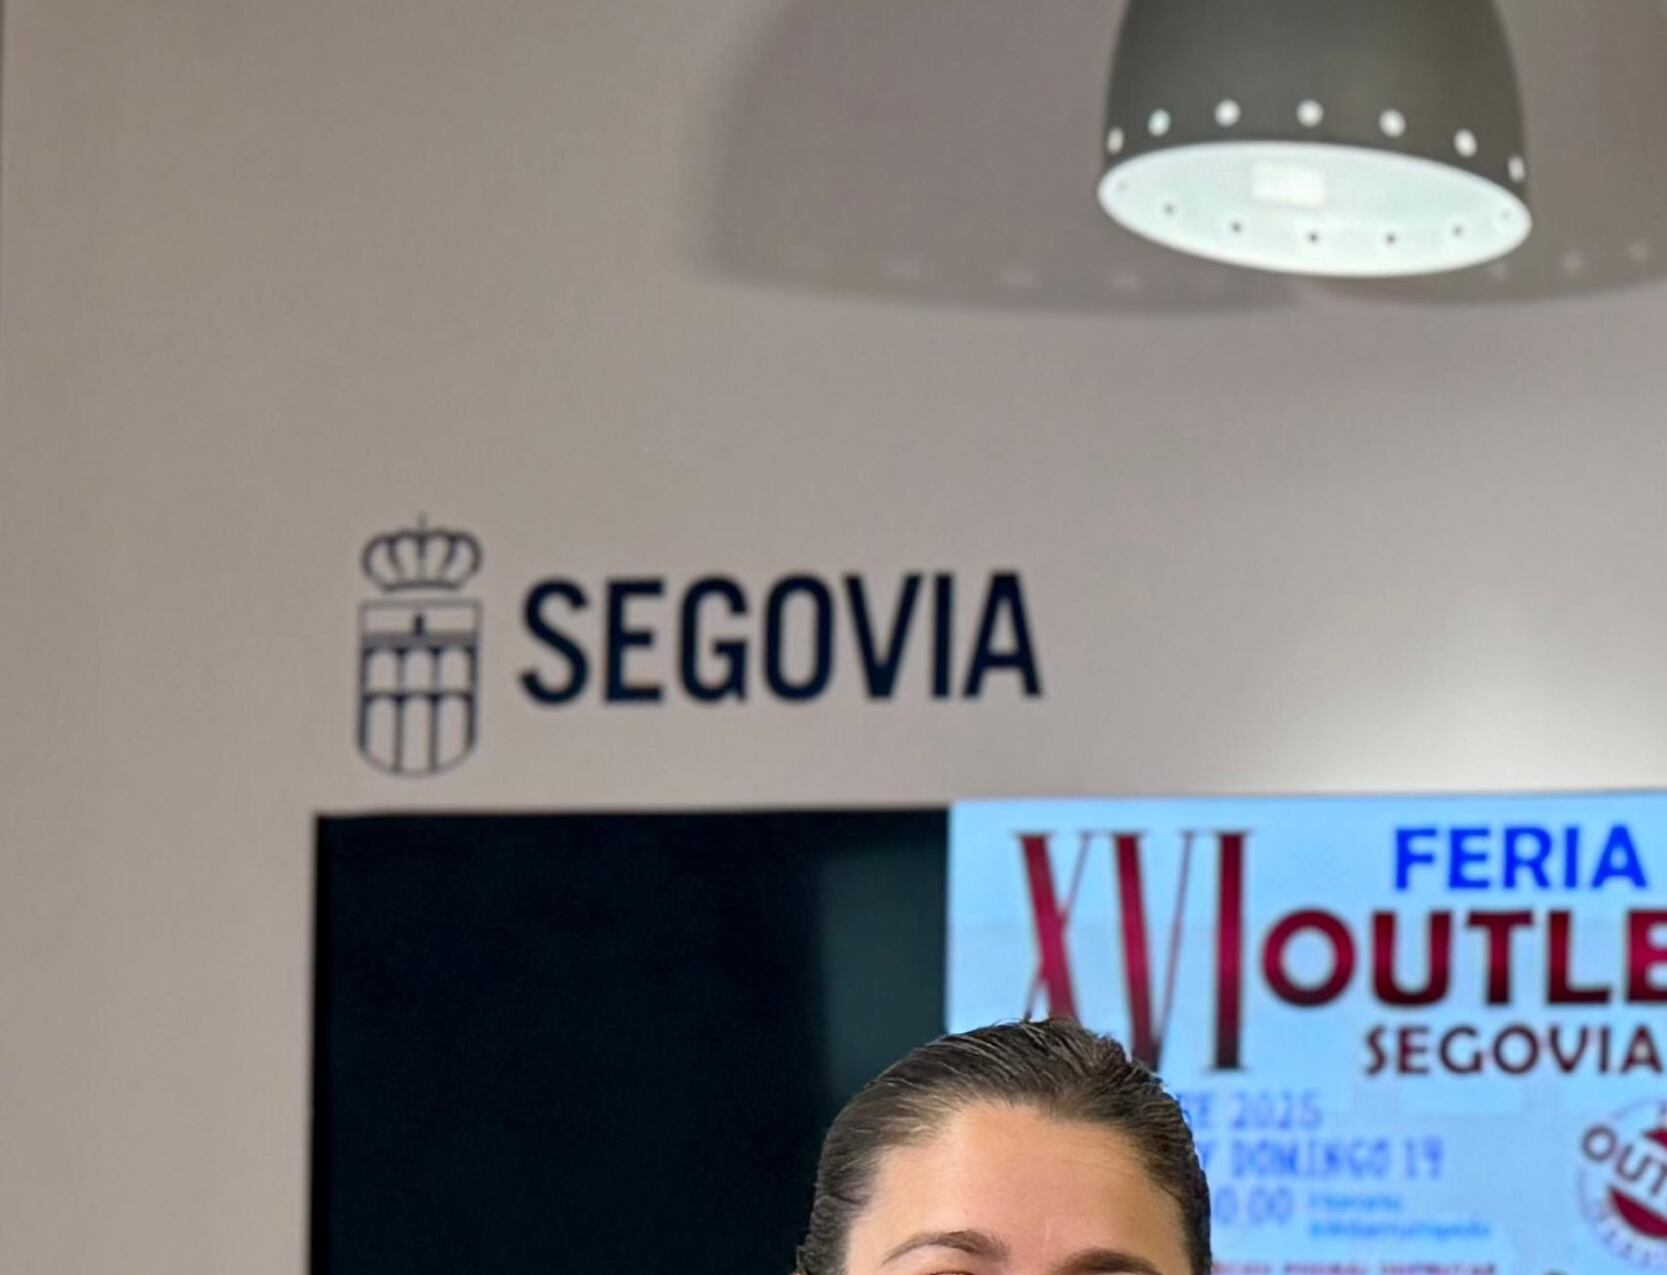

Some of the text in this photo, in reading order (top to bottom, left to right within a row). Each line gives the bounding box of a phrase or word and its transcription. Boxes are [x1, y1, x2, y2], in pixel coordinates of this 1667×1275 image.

[518, 570, 1044, 707] SEGOVIA
[1391, 823, 1650, 892] FERIA
[1011, 828, 1256, 1074] XVI
[1364, 1023, 1665, 1077] SEGOVIA
